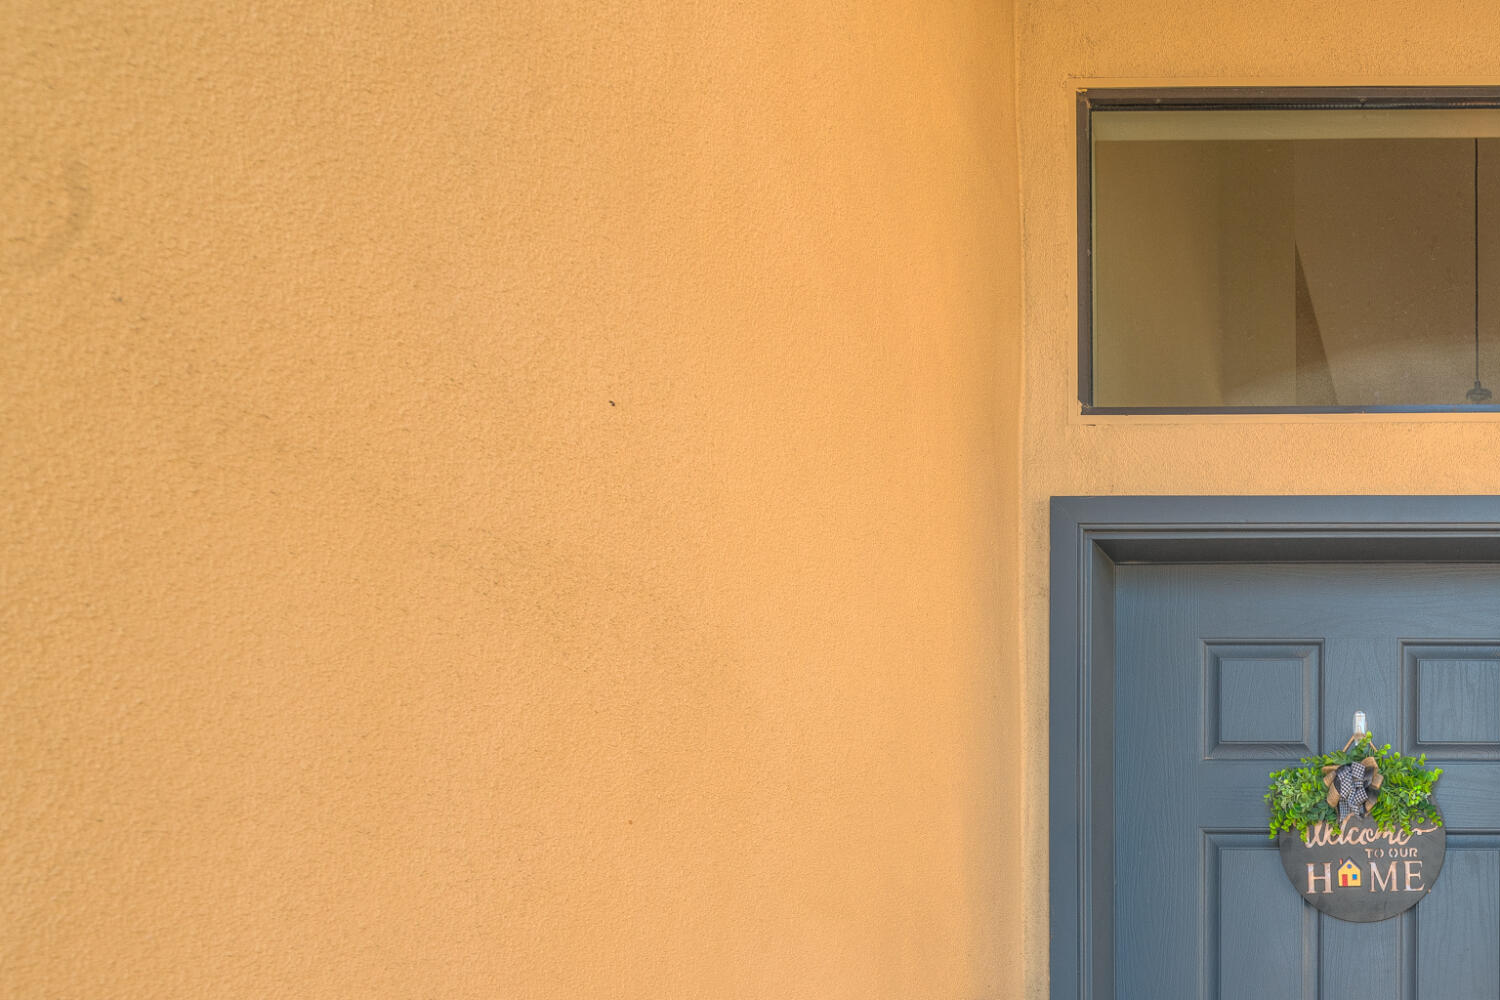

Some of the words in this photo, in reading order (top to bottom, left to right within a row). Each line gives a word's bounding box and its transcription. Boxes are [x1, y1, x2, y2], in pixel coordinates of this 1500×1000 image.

[1305, 812, 1438, 848] Welcome
[1365, 848, 1384, 859] TO
[1388, 848, 1418, 858] OUR
